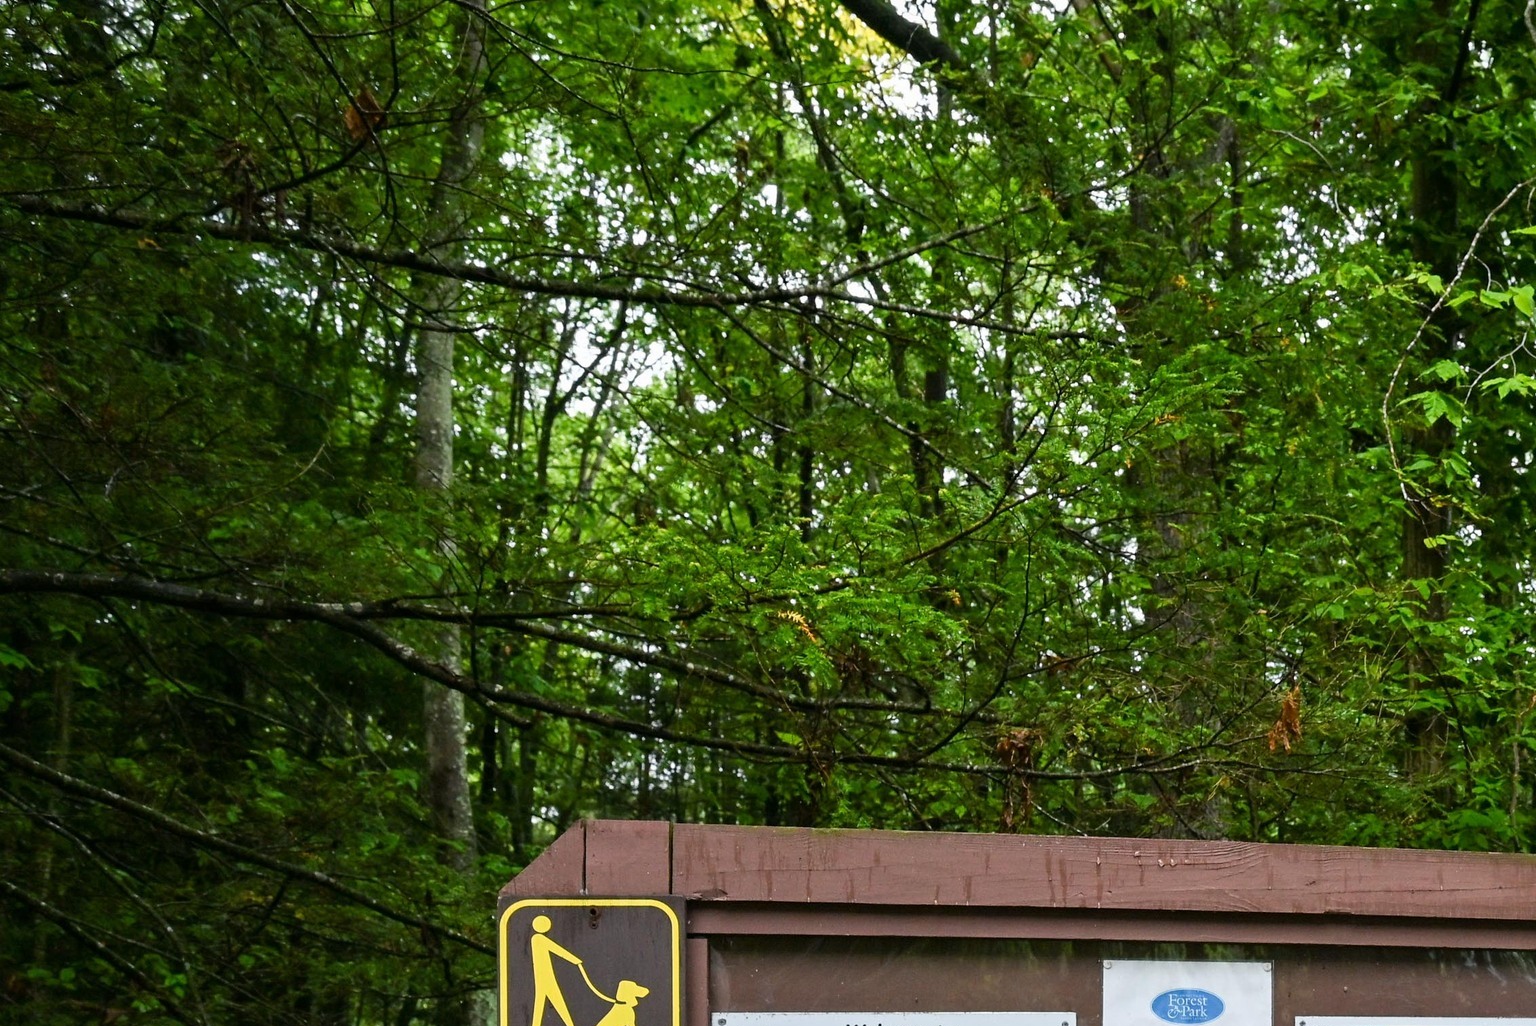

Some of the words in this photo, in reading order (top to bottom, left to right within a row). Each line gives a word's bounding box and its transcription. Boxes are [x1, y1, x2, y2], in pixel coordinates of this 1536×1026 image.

[1168, 993, 1208, 1007] Forest
[1167, 1006, 1182, 1019] &
[1182, 1006, 1208, 1018] Park
